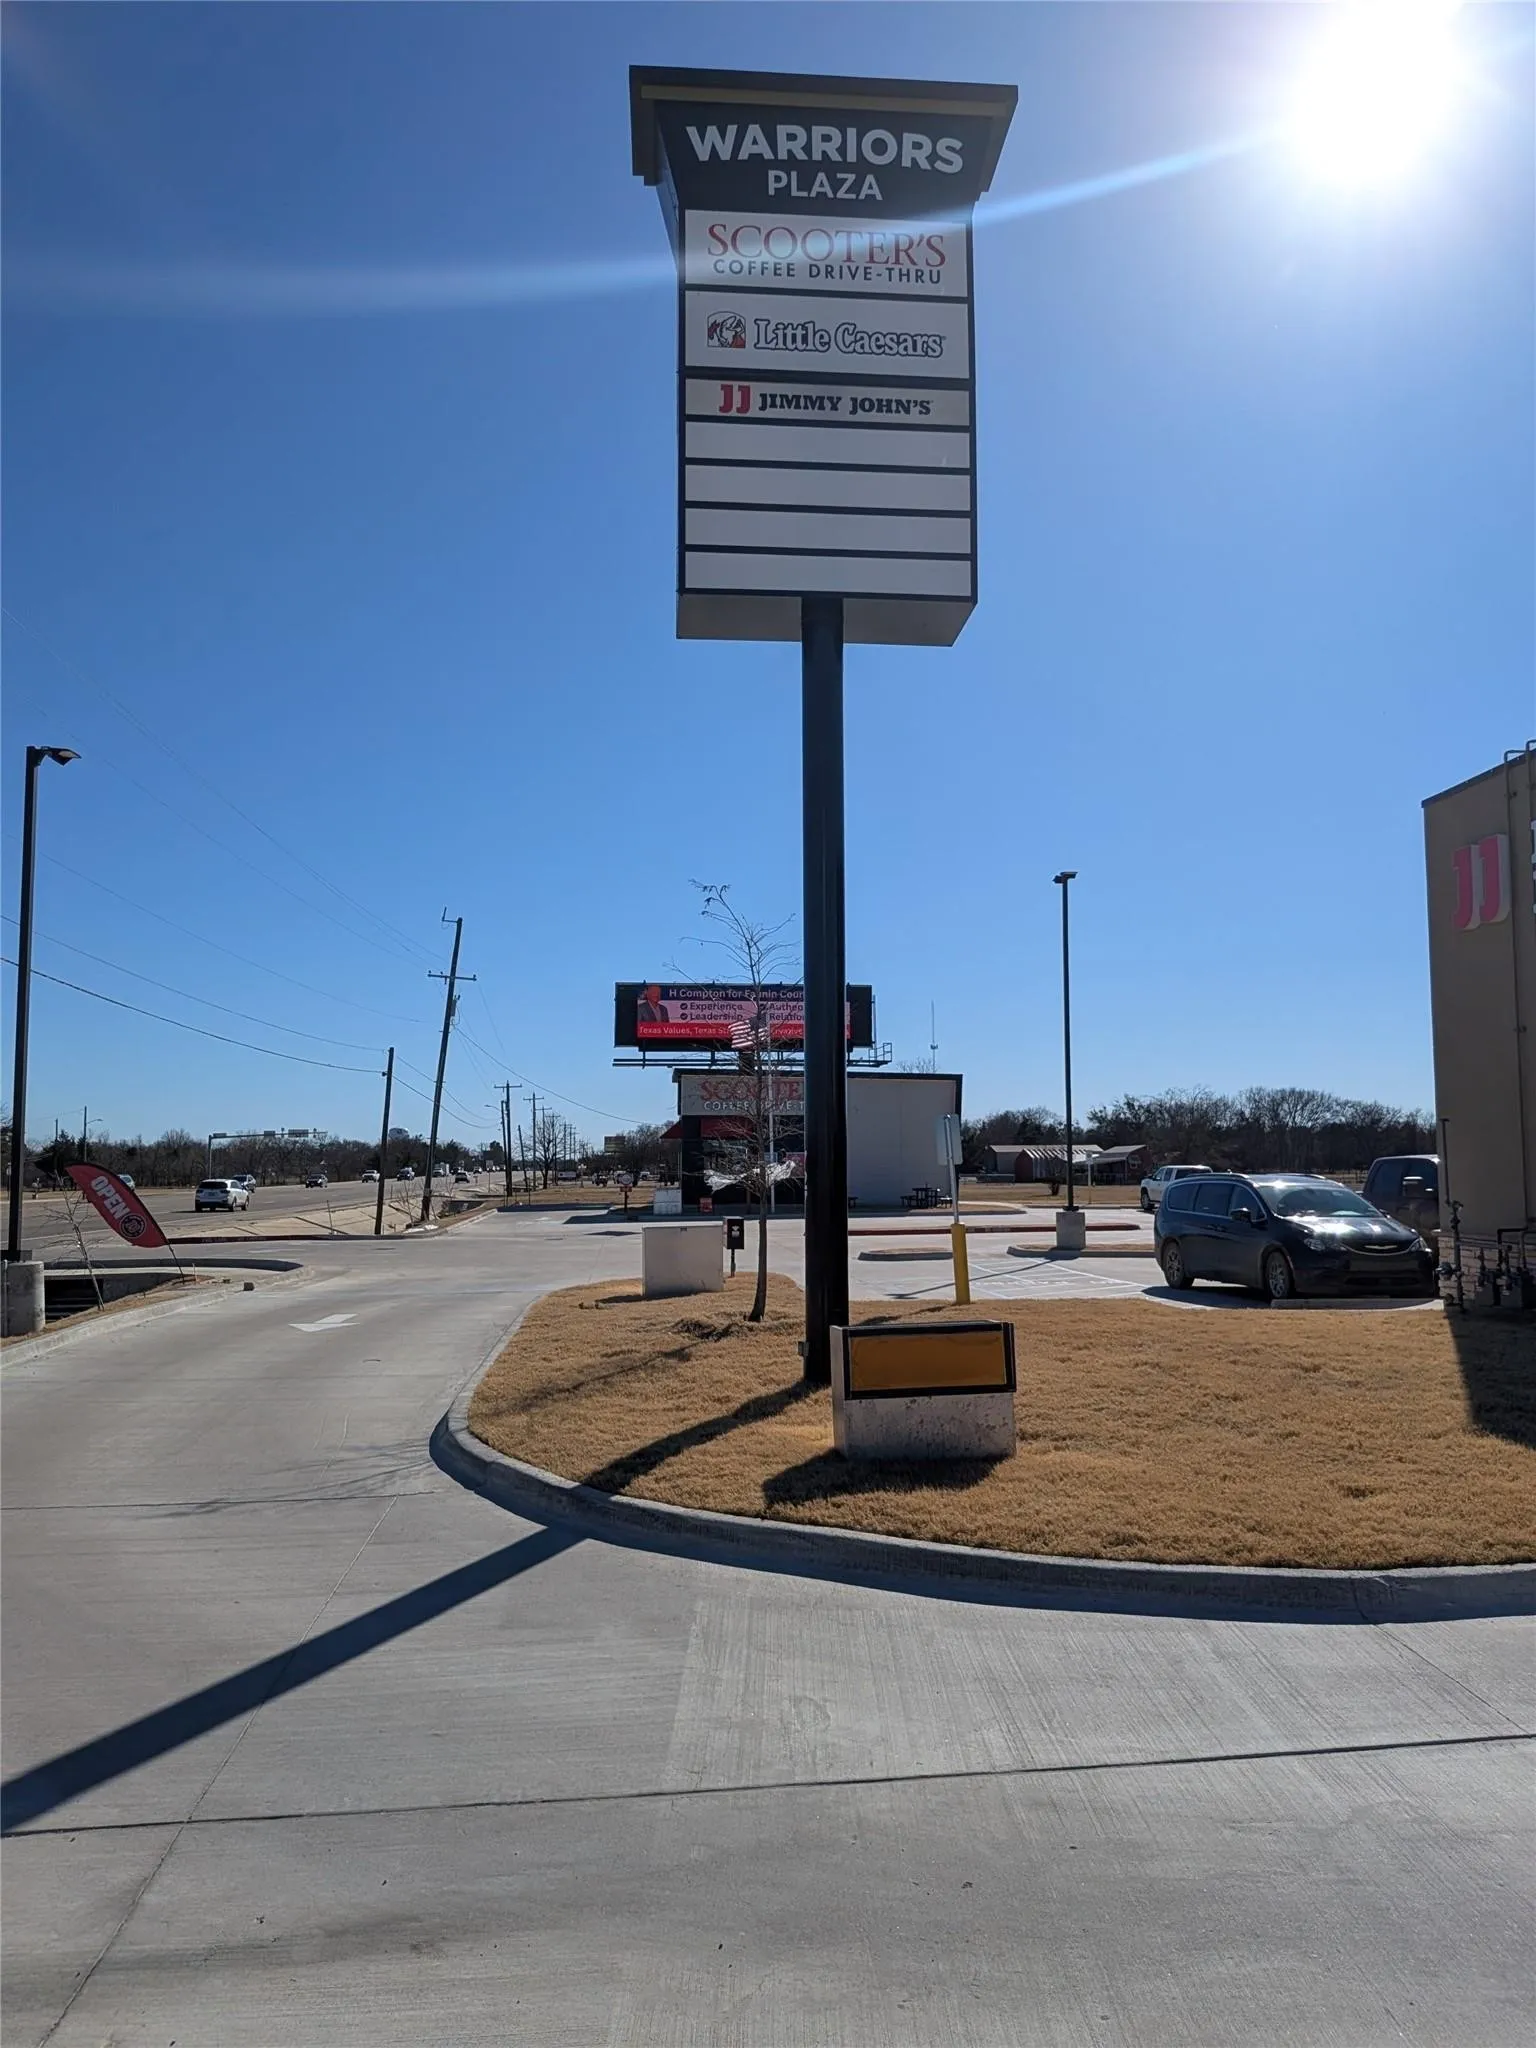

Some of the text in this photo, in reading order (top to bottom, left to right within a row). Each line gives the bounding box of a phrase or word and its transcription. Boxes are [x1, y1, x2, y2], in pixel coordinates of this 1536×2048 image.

[686, 124, 963, 174] WARRIORS
[767, 170, 883, 200] PLAZA
[707, 223, 946, 267] SCOOTER'S
[713, 259, 941, 285] COFFEE DRIVE-THRU
[754, 319, 943, 358] Little Caesars
[719, 384, 931, 416] JJ JIMMY JOHN'S
[1452, 833, 1511, 932] JJ
[669, 989, 677, 997] H
[680, 988, 726, 1000] Compton
[690, 1003, 743, 1012] Experience
[663, 1027, 693, 1036] Values,
[695, 1027, 716, 1035] Texas
[91, 1176, 130, 1219] OPEN
